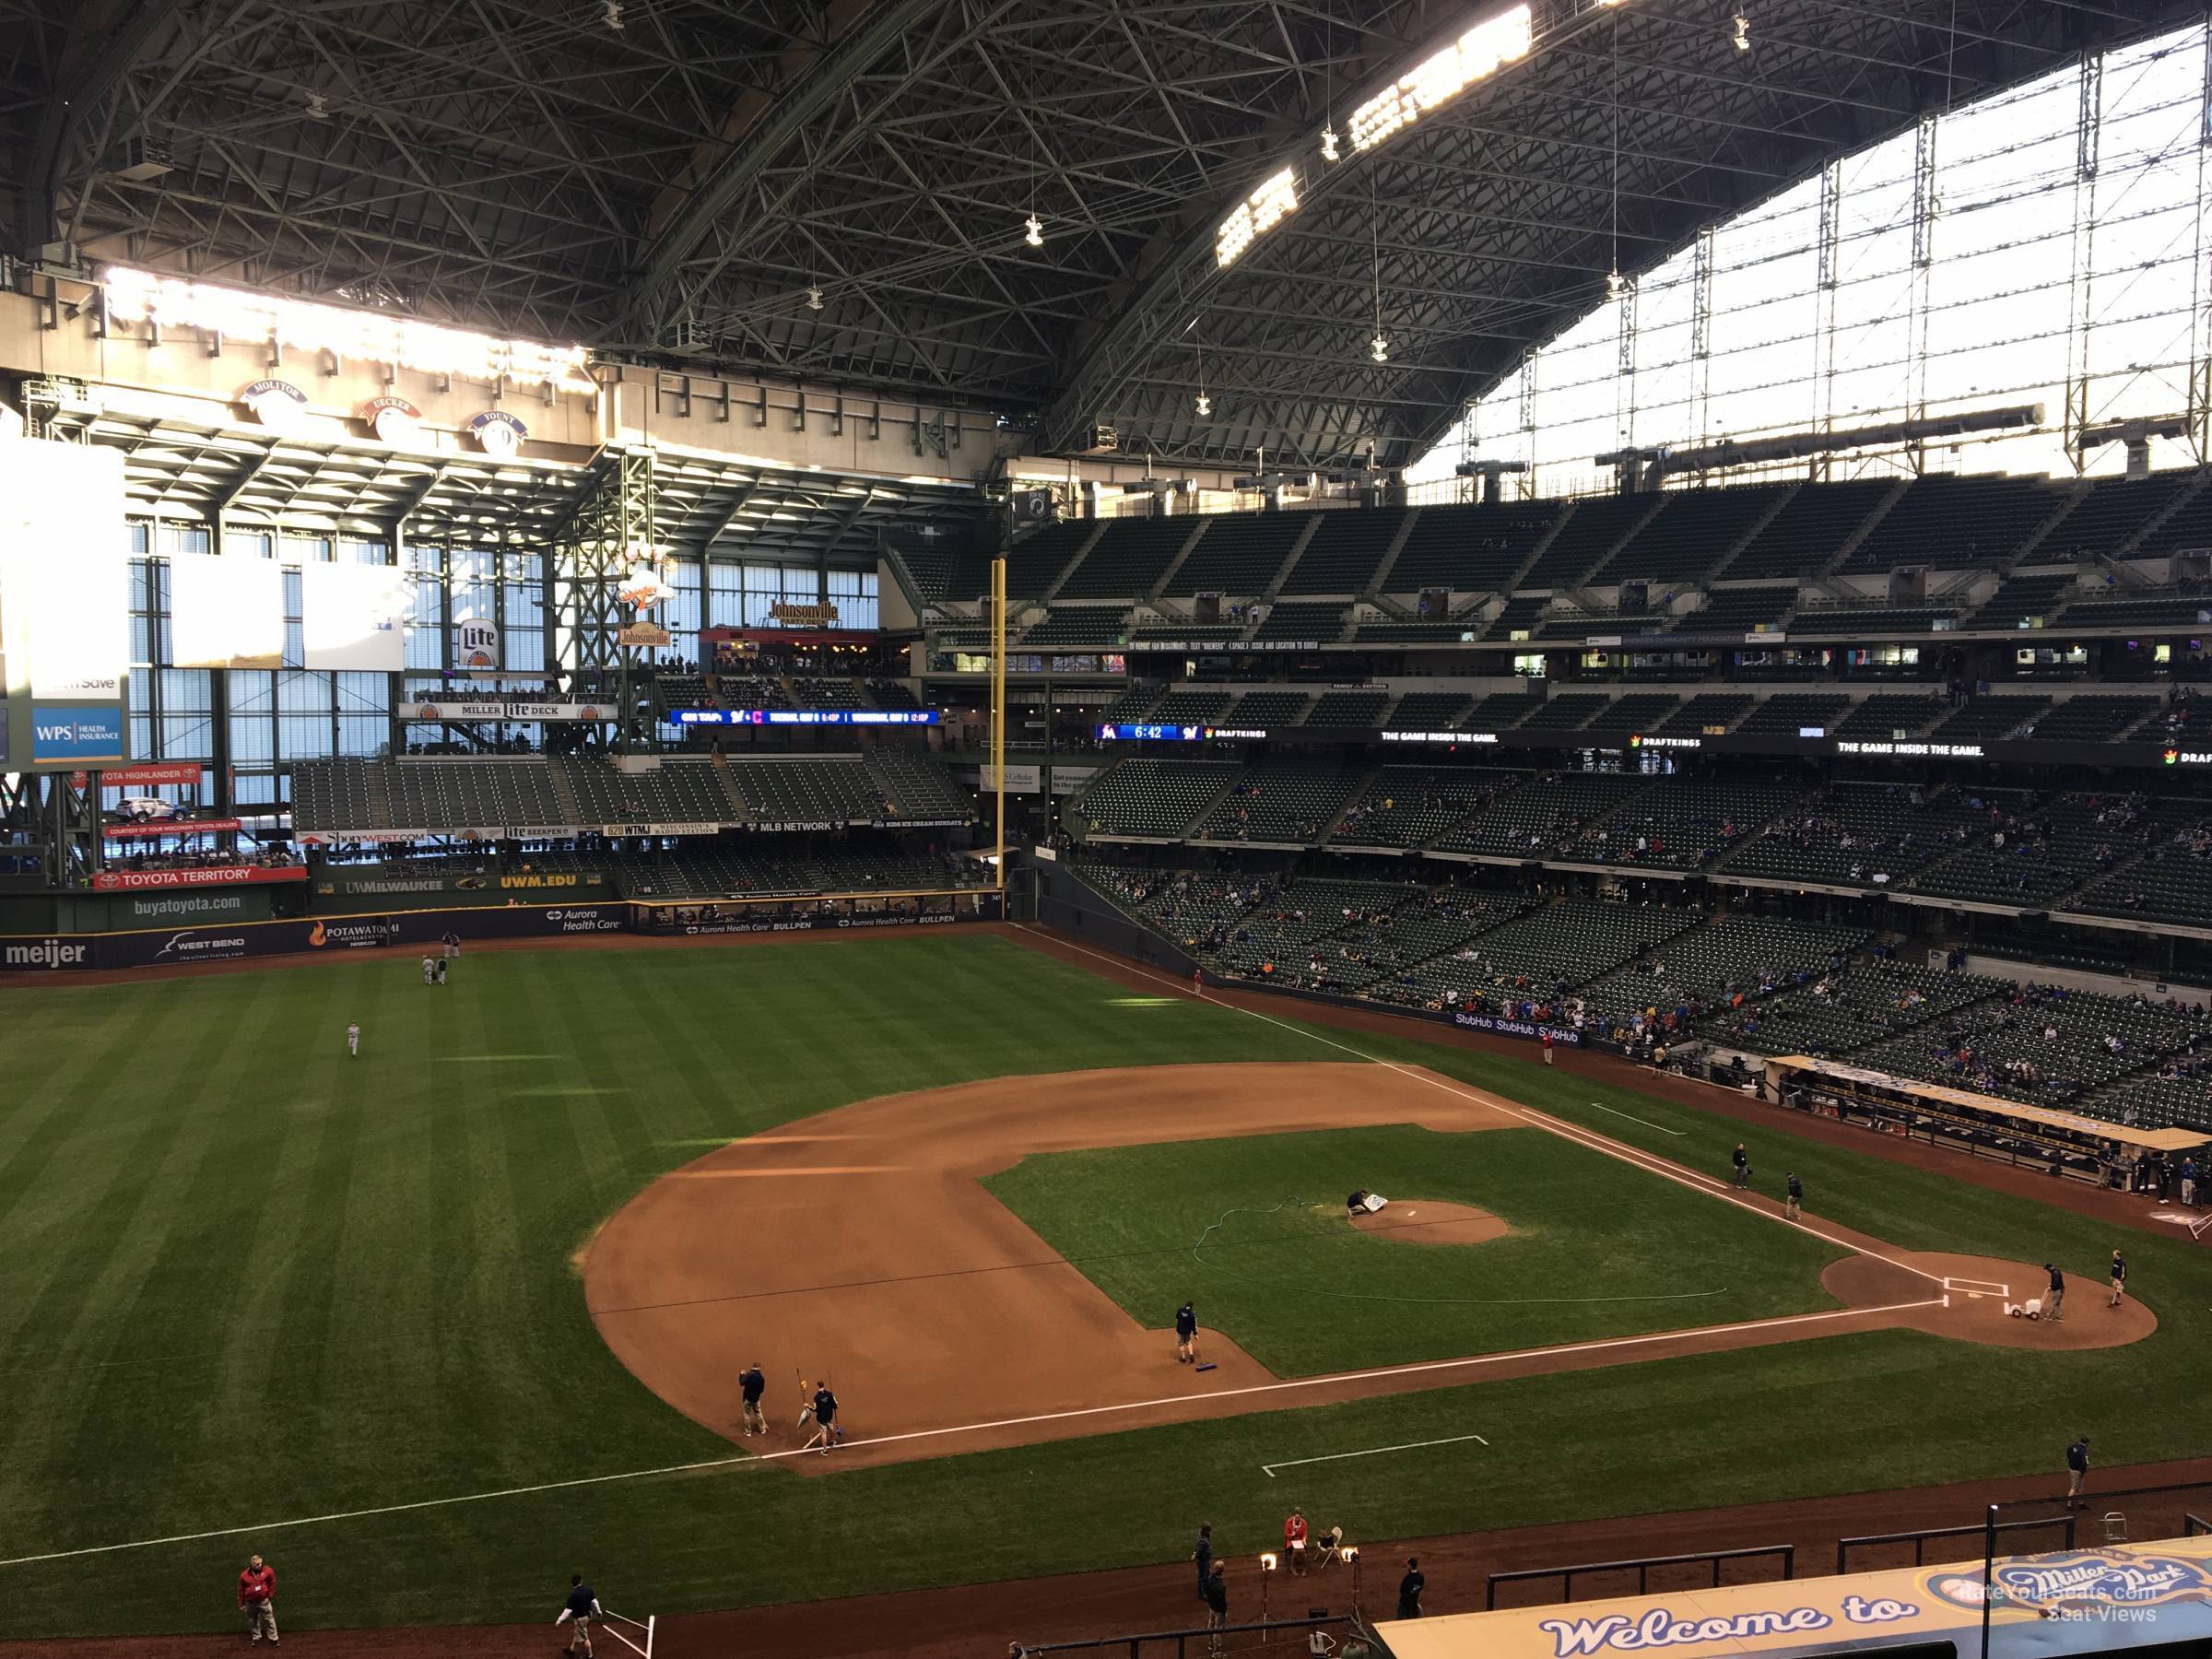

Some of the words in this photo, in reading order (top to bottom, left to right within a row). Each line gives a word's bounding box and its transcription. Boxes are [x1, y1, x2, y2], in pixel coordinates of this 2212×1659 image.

[255, 381, 300, 399] MOLITOR
[374, 397, 411, 412] UECKER
[485, 412, 514, 425] YOUNT
[769, 599, 838, 618] Johnsonville
[464, 628, 495, 650] Lite
[621, 630, 668, 644] Johnsonville
[462, 706, 501, 714] MILLER
[503, 703, 529, 719] Lite
[531, 706, 559, 714] DECK
[37, 725, 72, 741] WPS
[79, 725, 106, 734] HEALTH
[1135, 726, 1161, 738] 6:42
[1215, 730, 1266, 738] DRAFTKINGS
[79, 733, 119, 741] INSURANCE
[1382, 732, 1400, 741] THE
[1400, 733, 1427, 741] GAME
[1428, 733, 1456, 741] INSIDE
[1456, 734, 1473, 742] THE
[1473, 734, 1499, 743] GAME.
[1642, 737, 1701, 747] DRAFTKINGS
[1838, 742, 1859, 753] THE
[1861, 743, 1893, 754] GAME
[1895, 744, 1929, 755] INSIDE
[1930, 745, 1950, 756] THE
[1951, 745, 1984, 757] GAME.
[125, 770, 181, 781] HIGHLANDER
[110, 827, 138, 835] COURTESY
[607, 825, 624, 836] 620
[625, 825, 651, 836] WTMJ
[760, 822, 782, 831] MLB
[783, 821, 832, 831] NETWORK
[123, 873, 179, 887] TOYOTA
[181, 869, 252, 883] TERRITORY
[500, 875, 576, 888] UWM.EDU
[135, 897, 241, 916] buyatoyota.com
[564, 910, 597, 920] Aurora
[851, 919, 875, 927] Aurora
[919, 915, 955, 924] BULLPEN
[562, 920, 595, 931] Health
[597, 920, 619, 930] Care
[700, 926, 724, 935] Aurora
[726, 924, 750, 933] Health
[752, 924, 769, 932] Care
[772, 922, 812, 930] BULLPEN
[177, 941, 211, 950] WEST
[212, 938, 244, 948] BEND
[6, 939, 87, 968] meijer
[1455, 1013, 1492, 1029] StubHub
[1496, 1020, 1535, 1035] StubHub
[2006, 1565, 2108, 1598] Miller
[2105, 1564, 2190, 1594] Park
[1541, 1608, 1831, 1658] Welcome
[1842, 1595, 1920, 1625] to
